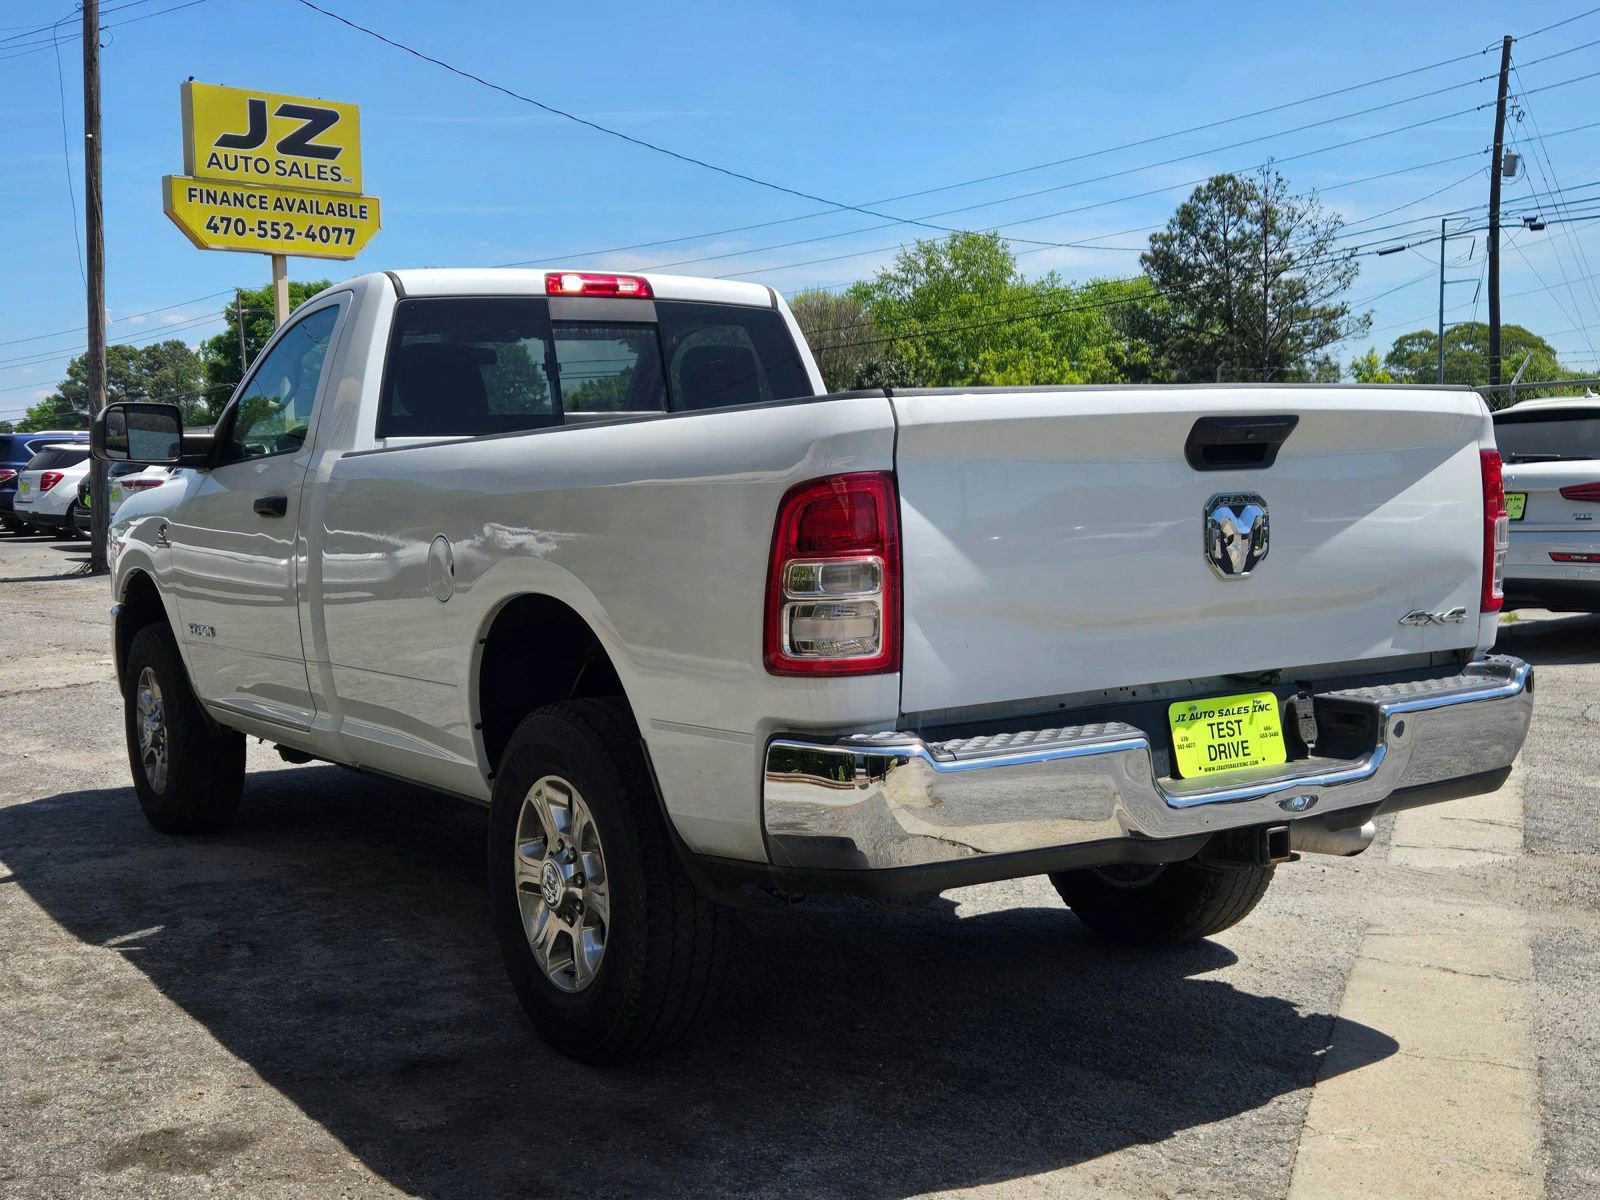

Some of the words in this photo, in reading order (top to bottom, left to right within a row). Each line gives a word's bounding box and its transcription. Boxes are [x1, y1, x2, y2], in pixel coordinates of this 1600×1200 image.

[213, 98, 343, 161] JZ
[206, 152, 270, 175] AUTO
[275, 161, 342, 183] SALES
[187, 187, 269, 211] FINANCE
[273, 197, 368, 220] AVAILABLE
[205, 215, 356, 245] 470-552-4077
[1175, 713, 1187, 723] JZ
[1189, 710, 1215, 721] AUTO
[1217, 705, 1250, 717] SALES
[1207, 719, 1243, 740] TEST
[1207, 740, 1251, 762] DRIVE
